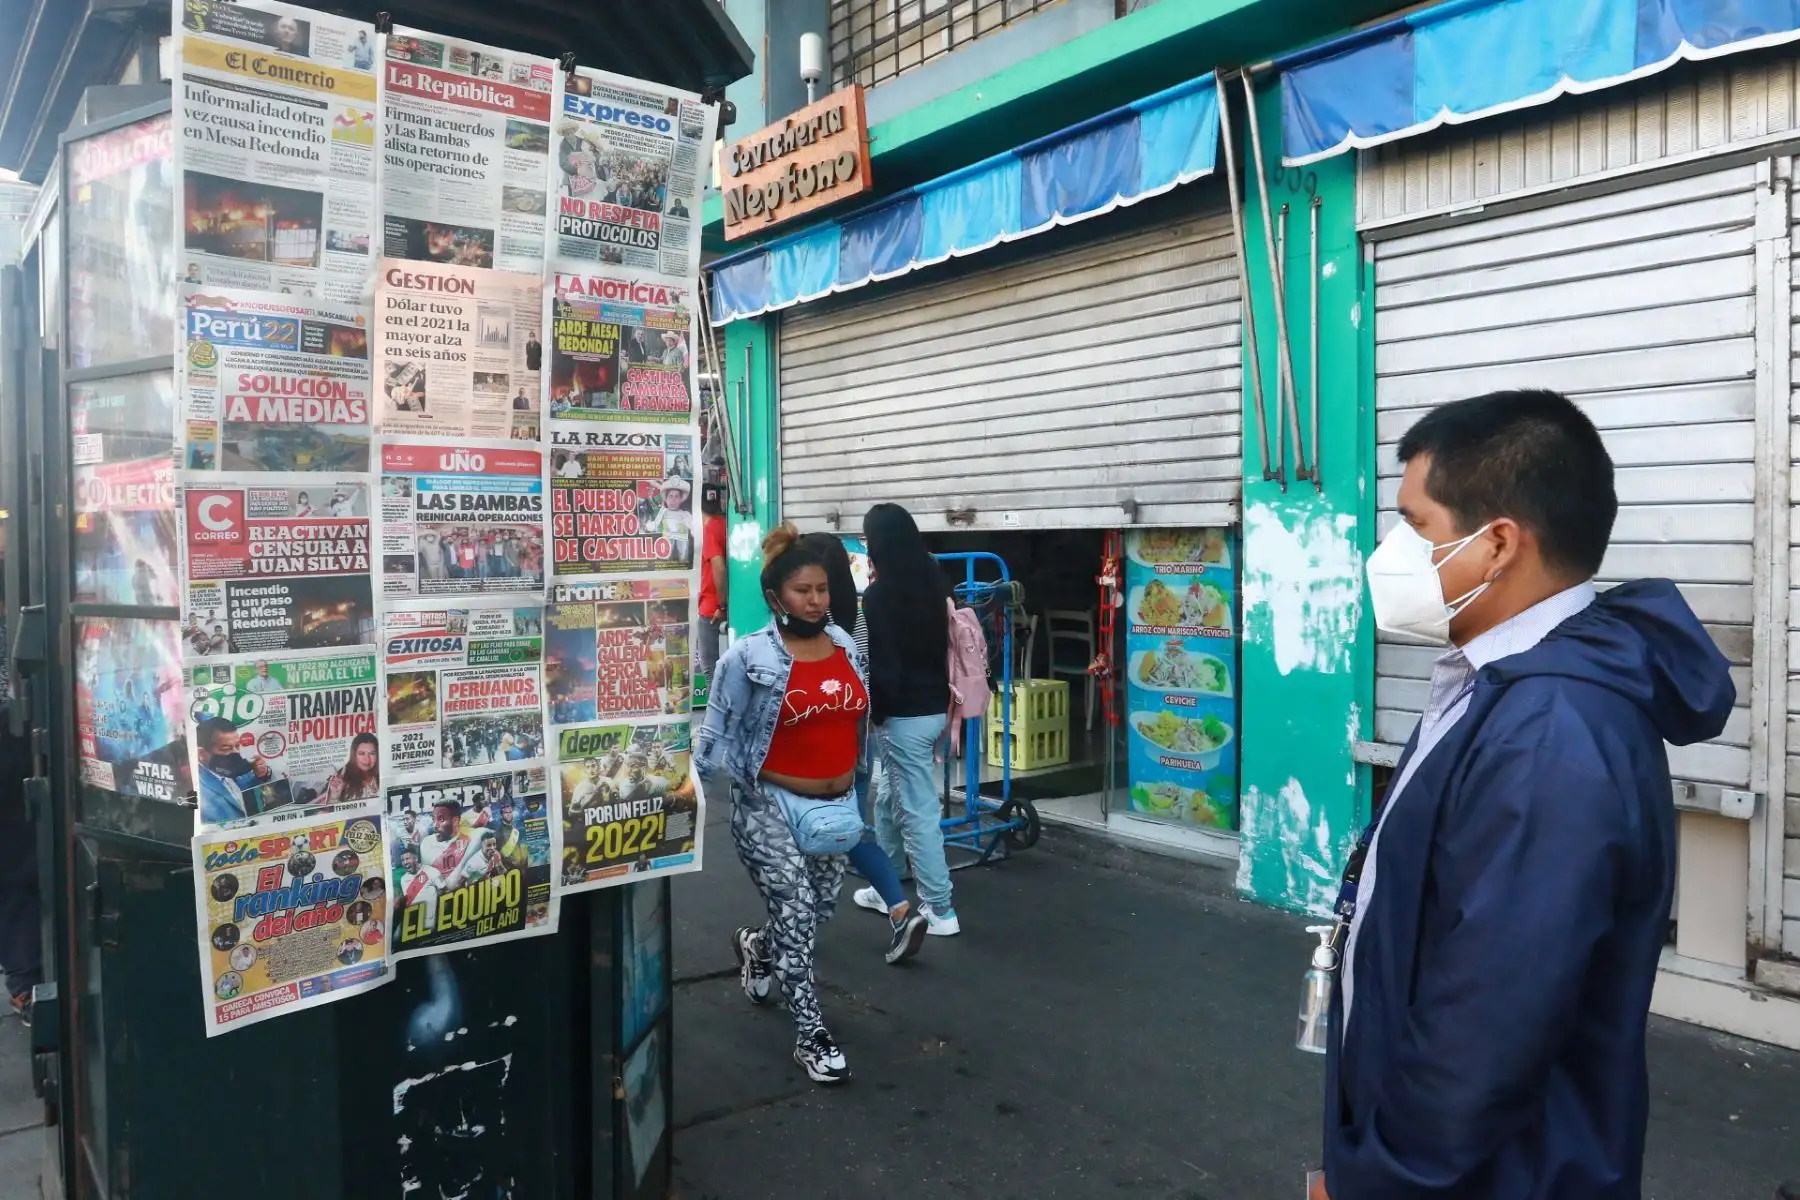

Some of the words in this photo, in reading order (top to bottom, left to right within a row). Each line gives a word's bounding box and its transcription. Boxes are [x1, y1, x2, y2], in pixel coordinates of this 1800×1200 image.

[225, 52, 248, 71] El
[252, 56, 335, 90] Comercio
[389, 67, 413, 88] La
[416, 72, 515, 109] República
[184, 85, 292, 121] Informalidad
[293, 109, 324, 127] otra
[564, 95, 671, 132] Expreso
[184, 106, 208, 122] vez
[209, 113, 254, 132] causa
[258, 119, 326, 145] incendio
[385, 106, 432, 127] Firman
[435, 116, 495, 138] acuerdos
[184, 125, 203, 139] en
[206, 128, 246, 151] Mesa
[250, 137, 320, 161] Redonda
[385, 124, 393, 136] y
[395, 125, 417, 139] Las
[419, 128, 470, 148] Bambas
[385, 138, 417, 154] alista
[420, 145, 470, 163] retorno
[472, 151, 489, 166] de
[384, 154, 404, 167] sus
[406, 157, 486, 180] operaciones
[726, 151, 857, 226] Neptuno
[560, 196, 584, 217] NO
[589, 201, 660, 231] RESPETA
[560, 218, 657, 248] PROTOCOLOS
[386, 268, 475, 295] GESTIÓN
[555, 275, 585, 295] LA
[387, 297, 427, 312] Dólar
[430, 302, 463, 316] tuvo
[385, 315, 403, 325] en
[405, 316, 418, 327] el
[421, 316, 453, 330] 2021
[457, 319, 470, 332] la
[554, 320, 588, 338] ¡ARDE
[591, 323, 619, 340] MESA
[385, 330, 431, 345] mayor
[434, 333, 462, 346] alza
[558, 334, 614, 355] REDONDA!
[385, 346, 403, 357] en
[405, 346, 430, 359] seis
[433, 347, 467, 362] años
[238, 373, 348, 398] SOLUCIÓN
[627, 369, 681, 385] CASTILLO
[228, 397, 251, 421] A
[256, 398, 366, 423] MEDIAS
[620, 397, 632, 410] A
[551, 432, 583, 445] LA
[439, 454, 486, 472] UNO
[416, 493, 456, 510] LAS
[460, 493, 543, 511] BAMBAS
[553, 489, 570, 513] EL
[573, 489, 637, 513] PUEBLO
[416, 511, 477, 522] REINICIARÁ
[478, 513, 543, 522] OPERACIONES
[553, 514, 574, 536] SE
[195, 532, 239, 540] CORREO
[248, 524, 368, 541] REACTIVAN
[249, 539, 349, 557] CENSURA
[352, 539, 368, 554] A
[555, 538, 578, 562] DE
[583, 537, 671, 561] CASTILLO
[248, 557, 304, 574] JUAN
[307, 556, 369, 572] SILVA
[1155, 565, 1173, 574] TRIO
[1174, 565, 1204, 574] MARINO
[230, 584, 289, 597] Incendio
[231, 600, 239, 608] a
[242, 599, 259, 608] un
[261, 597, 292, 608] paso
[231, 608, 249, 619] de
[251, 607, 287, 618] Mesa
[232, 617, 293, 630] Redonda
[1131, 625, 1151, 634] ARROZ
[1153, 626, 1166, 634] CON
[1167, 627, 1198, 636] MARISCOS
[1203, 628, 1231, 638] CEVICHE
[388, 637, 463, 654] EXITOSA
[597, 630, 634, 648] ARDE
[287, 671, 299, 683] NI
[302, 668, 333, 683] PARA
[336, 668, 349, 679] EL
[298, 662, 317, 671] 2022
[318, 661, 329, 669] NO
[597, 662, 642, 680] CERCA
[448, 679, 535, 699] PERUANOS
[598, 679, 617, 696] DE
[619, 677, 658, 695] MESA
[287, 686, 377, 720] TRAMPAY
[491, 696, 512, 708] DEL
[514, 692, 539, 706] AÑO
[597, 694, 661, 712] REDONDA
[784, 683, 867, 726] Smile
[1164, 695, 1197, 706] CEVICHE
[288, 721, 299, 732] EN
[288, 732, 299, 744] LA
[391, 743, 402, 752] SE
[404, 742, 415, 751] VA
[417, 740, 435, 749] CON
[402, 732, 424, 742] 2021
[567, 731, 622, 755] depor
[392, 749, 435, 761] INFIERNO
[1160, 756, 1202, 771] PARIHUELA
[133, 761, 175, 781] STAR
[135, 780, 174, 800] WARS
[614, 802, 632, 820] UN
[633, 797, 663, 816] FELIZ
[273, 815, 286, 823] POR
[585, 810, 665, 864] 2022!
[257, 864, 285, 892] El
[233, 873, 363, 922] ranking
[437, 869, 521, 932] EQUIPO
[253, 909, 293, 942] del
[294, 903, 344, 931] año
[402, 903, 431, 943] EL
[476, 916, 496, 936] DEL
[497, 908, 519, 928] AÑO
[218, 1013, 229, 1023] 15
[230, 1006, 251, 1020] PARA
[252, 993, 296, 1013] AMISTOSOS
[222, 995, 253, 1013] GARECA
[254, 986, 291, 1003] CONVOCA
